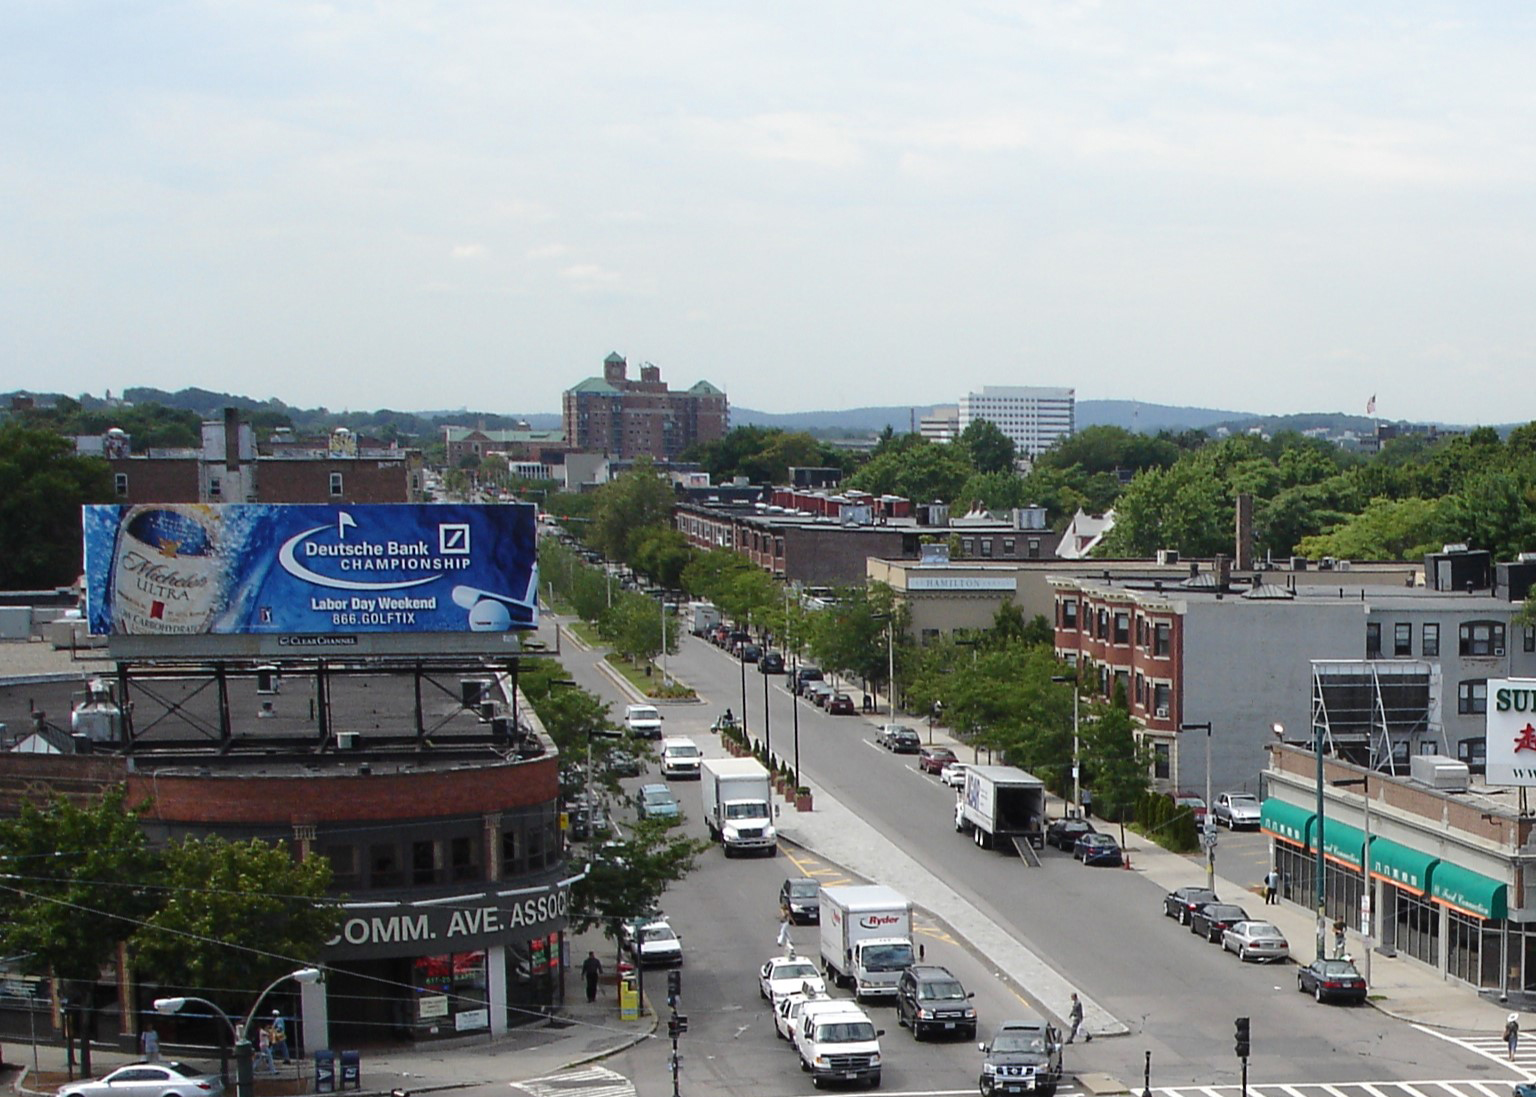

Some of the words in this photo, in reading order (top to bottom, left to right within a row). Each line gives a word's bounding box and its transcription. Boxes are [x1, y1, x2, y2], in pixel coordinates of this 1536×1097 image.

[305, 541, 382, 556] Deutsche
[388, 540, 429, 556] Bank
[340, 558, 471, 571] CHAMPIONSHIP
[136, 577, 190, 601] ULTRA
[926, 579, 981, 588] HAMILTON
[311, 597, 348, 610] Labor
[351, 597, 376, 612] Day
[378, 596, 436, 610] Weekend
[332, 611, 415, 625] 866.GOLFTIX
[447, 906, 505, 938] AVE.
[510, 890, 568, 928] ASSOC
[868, 915, 900, 925] Ryder
